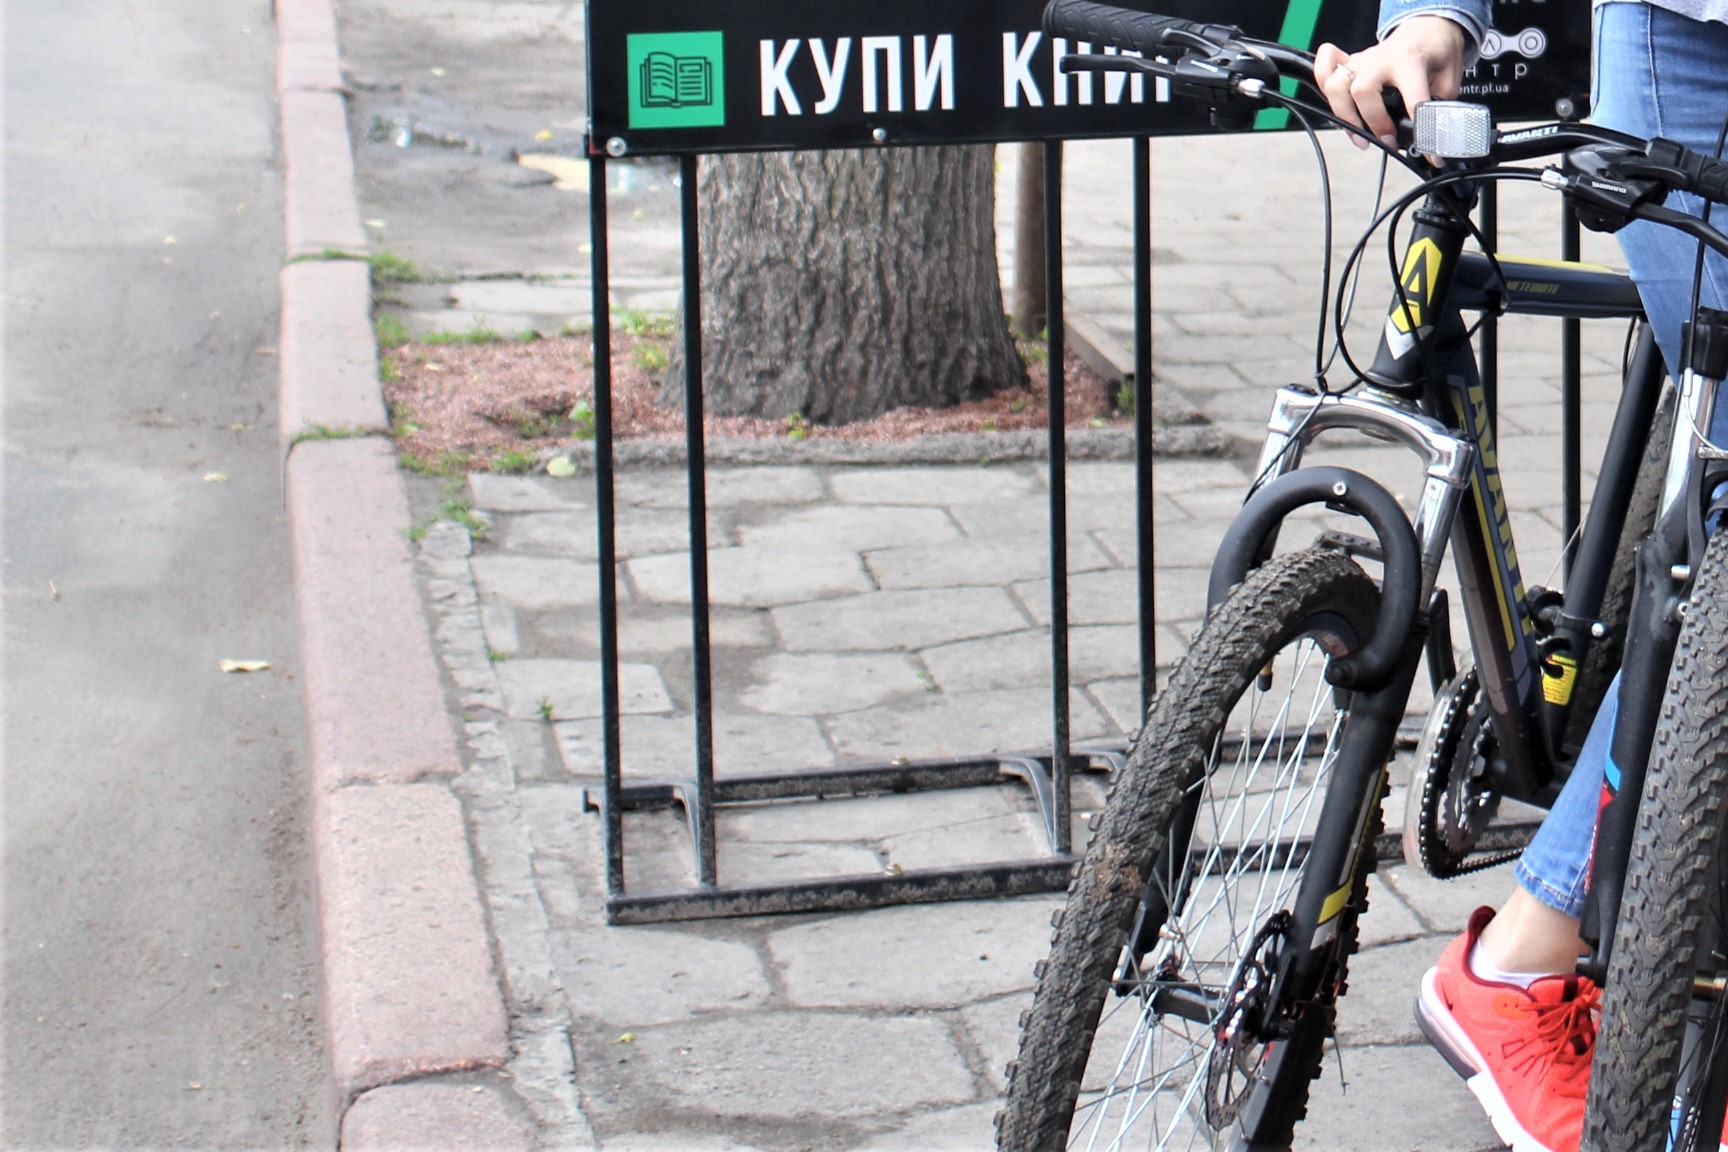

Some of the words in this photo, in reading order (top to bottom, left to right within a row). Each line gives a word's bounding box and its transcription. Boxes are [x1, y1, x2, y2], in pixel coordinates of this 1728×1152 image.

[759, 33, 954, 117] КУПИ
[1459, 85, 1509, 95] entr.pl.ua
[1500, 125, 1559, 144] AVANTI
